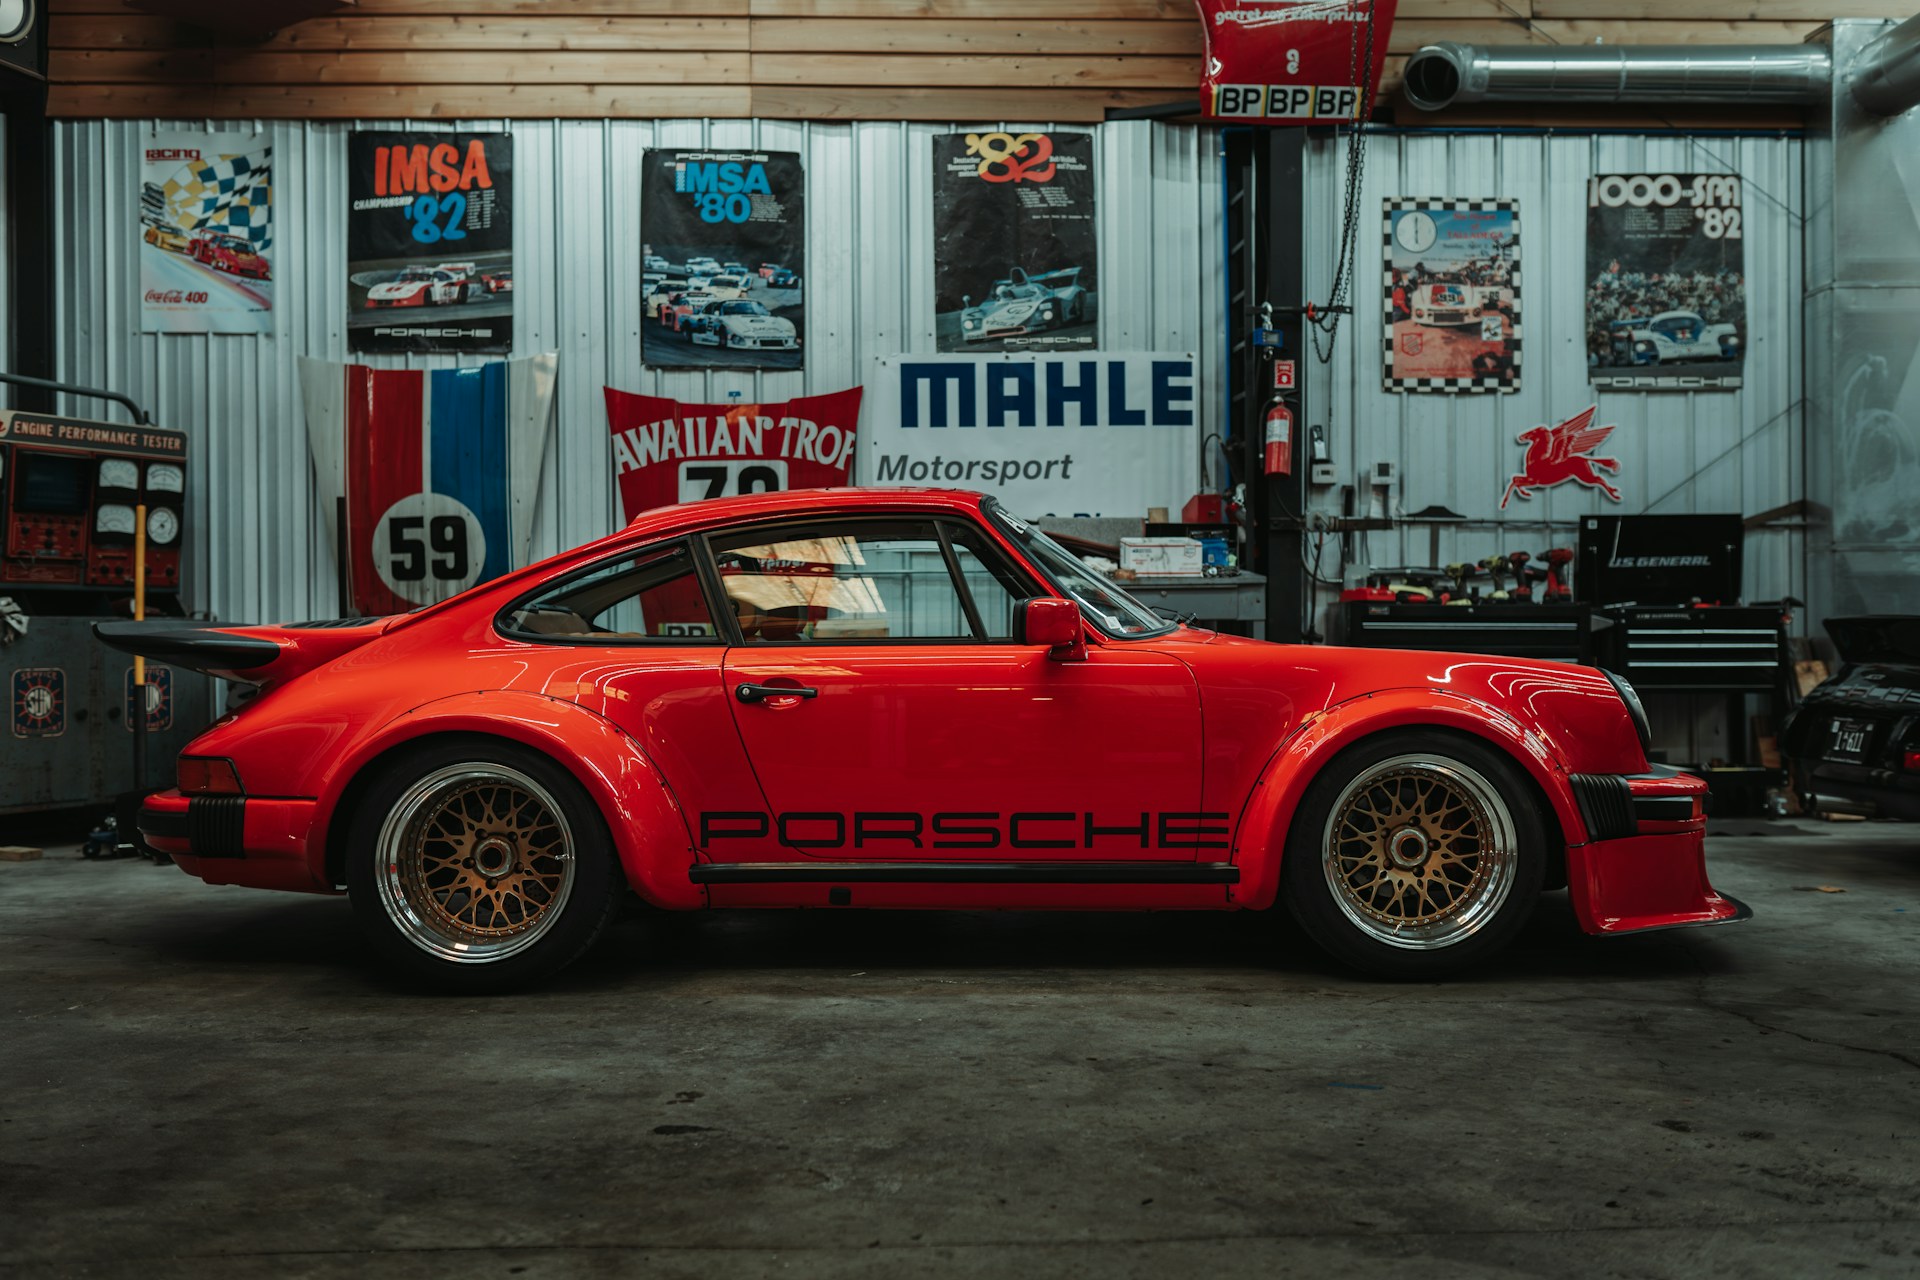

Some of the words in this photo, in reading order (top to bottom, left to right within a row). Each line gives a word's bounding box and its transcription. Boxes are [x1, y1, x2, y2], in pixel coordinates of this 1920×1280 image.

[1221, 88, 1261, 114] BP
[1269, 88, 1309, 114] BP
[1317, 89, 1356, 115] BP
[146, 148, 200, 161] racing
[374, 139, 493, 196] IMSA
[675, 153, 769, 162] PORSCHE
[675, 162, 772, 195] IMSA
[1590, 174, 1682, 207] 1000
[1691, 176, 1741, 206] SPA
[404, 192, 467, 244] '82
[693, 191, 752, 224] '80
[1695, 207, 1741, 239] '82
[185, 291, 208, 303] 400
[374, 328, 492, 337] PORSCHE
[901, 361, 1193, 428] MAHLE
[1590, 376, 1743, 387] PORSCHE
[13, 421, 53, 437] ENGINE
[58, 425, 138, 446] PERFORMANCE
[143, 434, 181, 450] TESTER
[611, 415, 774, 476] AWAIIAN
[876, 454, 1073, 486] Motorsport
[389, 515, 469, 581] 59
[1636, 555, 1711, 568] GENERAL
[26, 687, 52, 716] SUN
[700, 812, 1229, 848] PORSCHE
